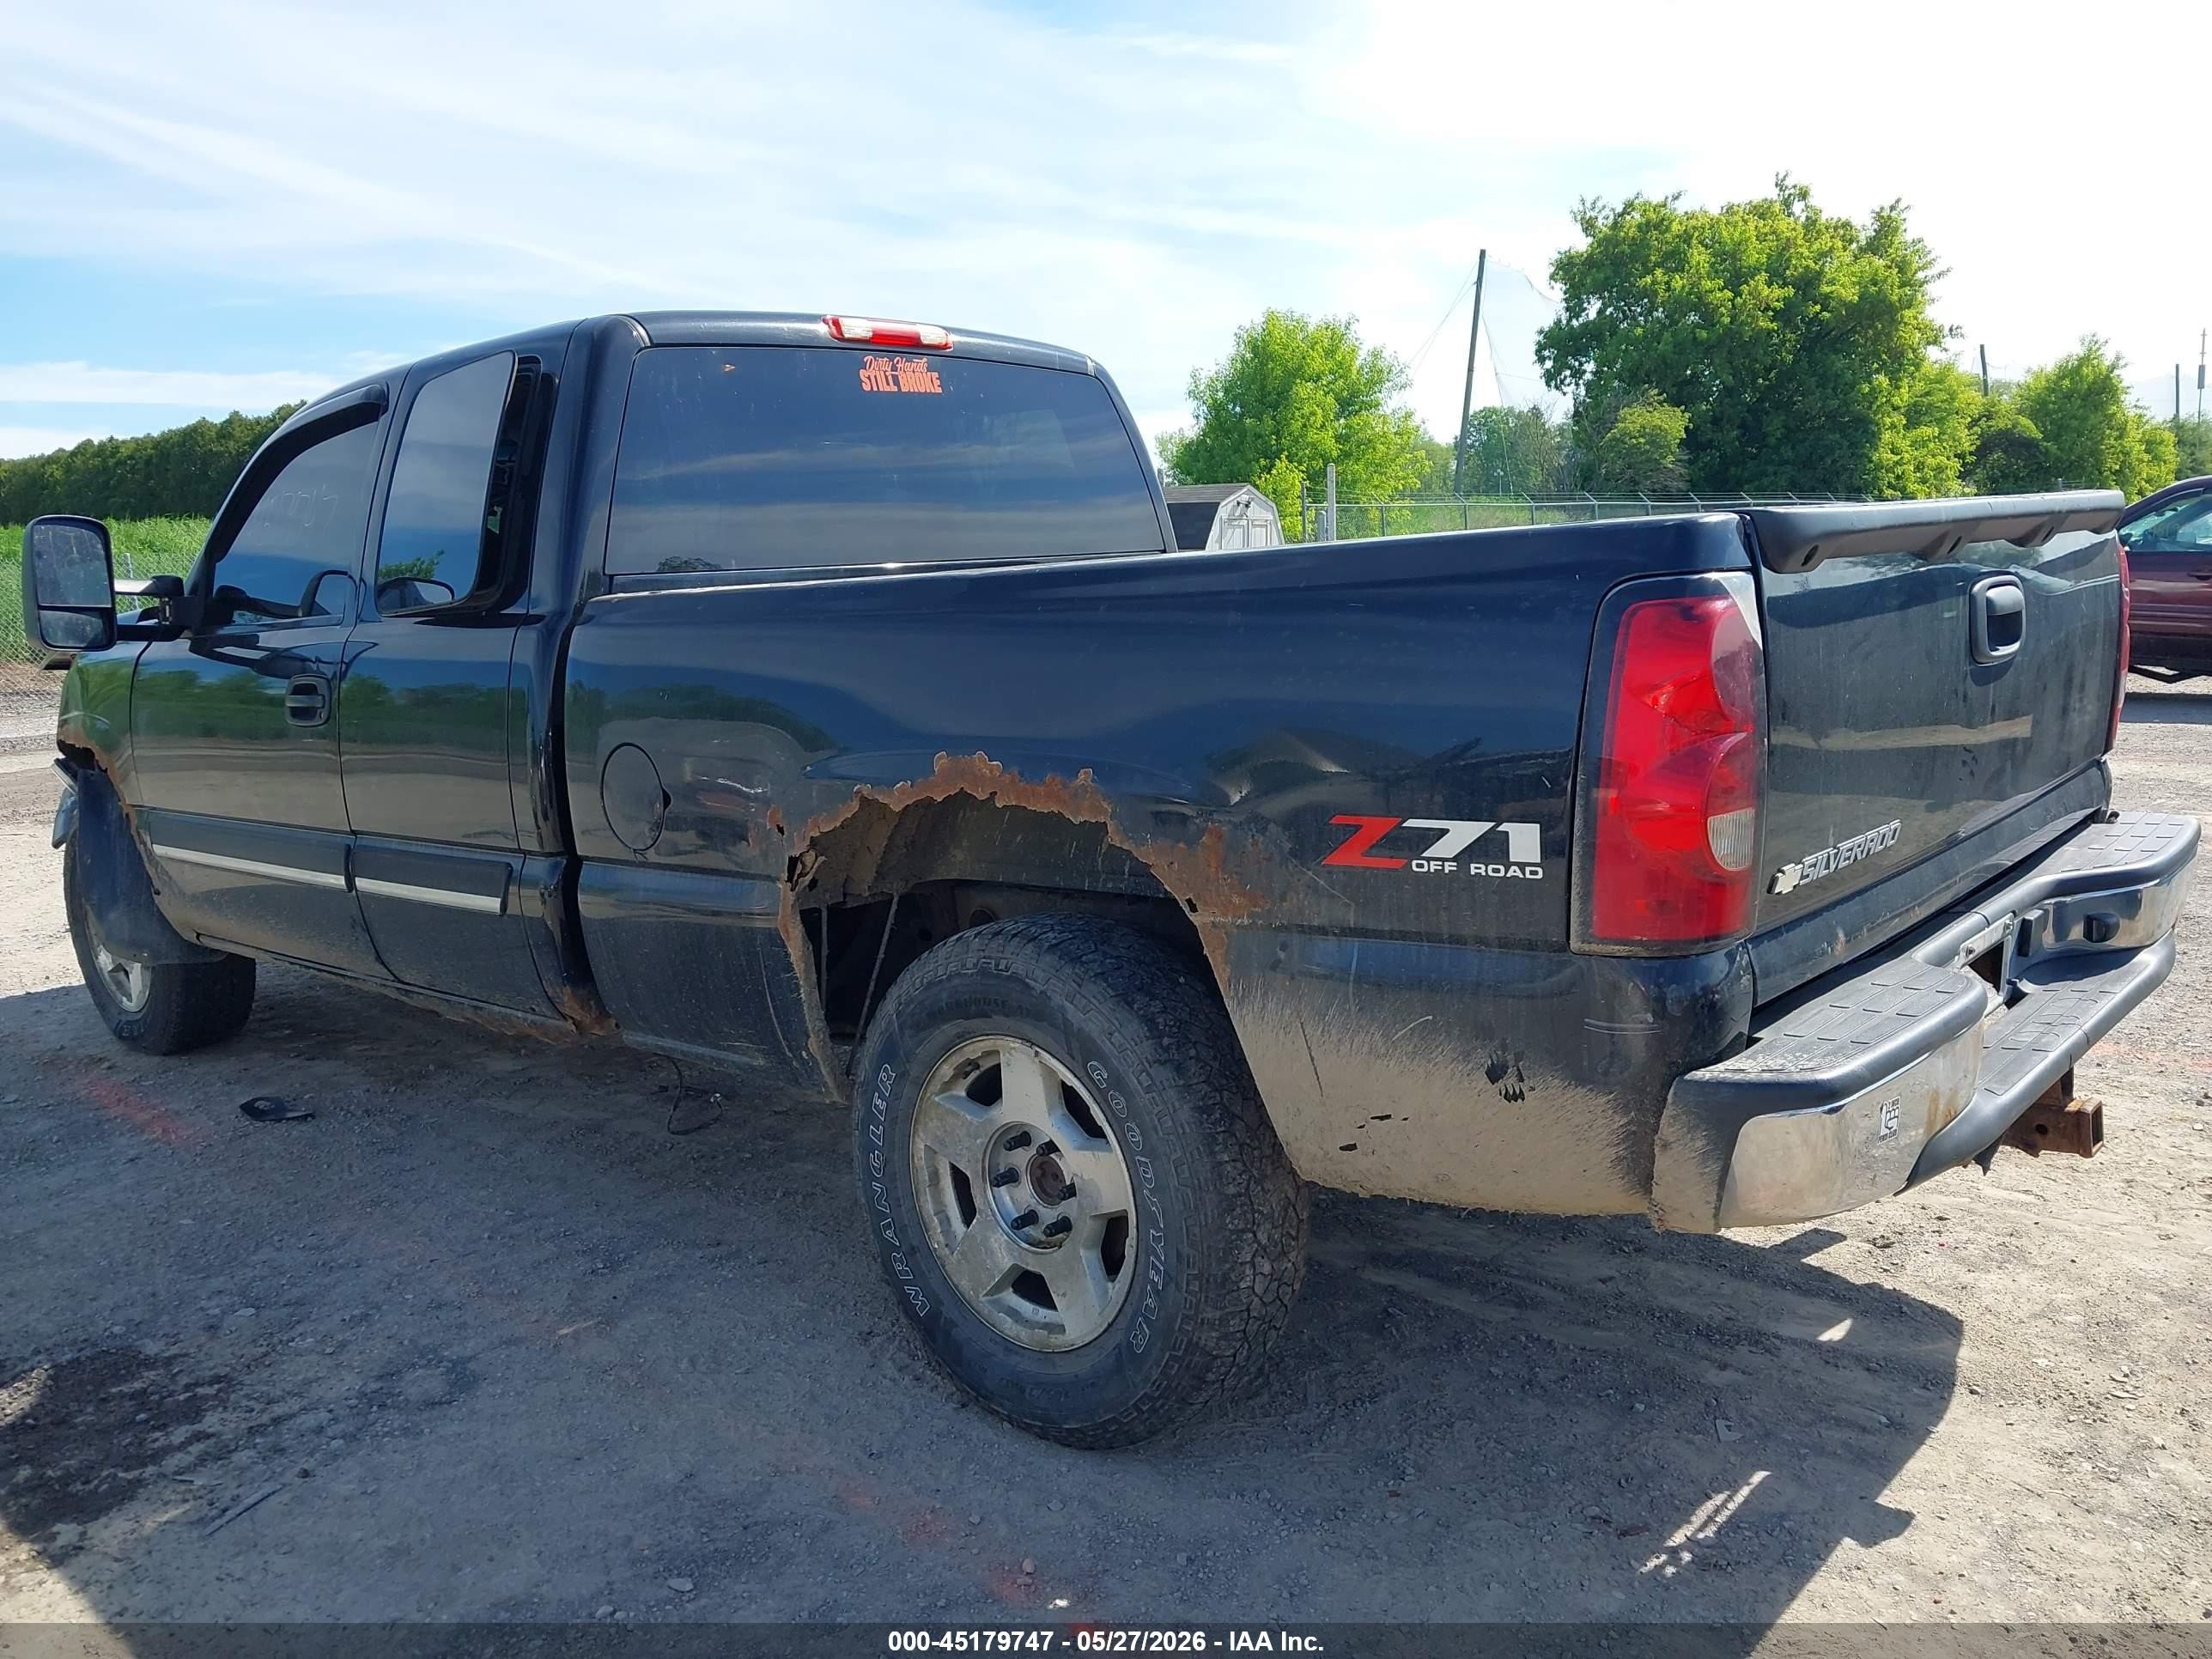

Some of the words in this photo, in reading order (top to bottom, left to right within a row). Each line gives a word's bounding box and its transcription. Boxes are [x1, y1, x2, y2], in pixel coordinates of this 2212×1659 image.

[860, 369, 898, 392] STILL
[899, 371, 943, 393] BROKE
[863, 355, 892, 373] Dirty
[894, 356, 928, 373] Hands
[1322, 814, 1541, 869] Z71
[1799, 818, 1902, 886] SILVERADO
[1411, 860, 1458, 874] OFF
[1469, 863, 1544, 879] ROAD
[868, 1063, 931, 1318] WRANGLER
[1087, 1060, 1168, 1354] GOODYEAR
